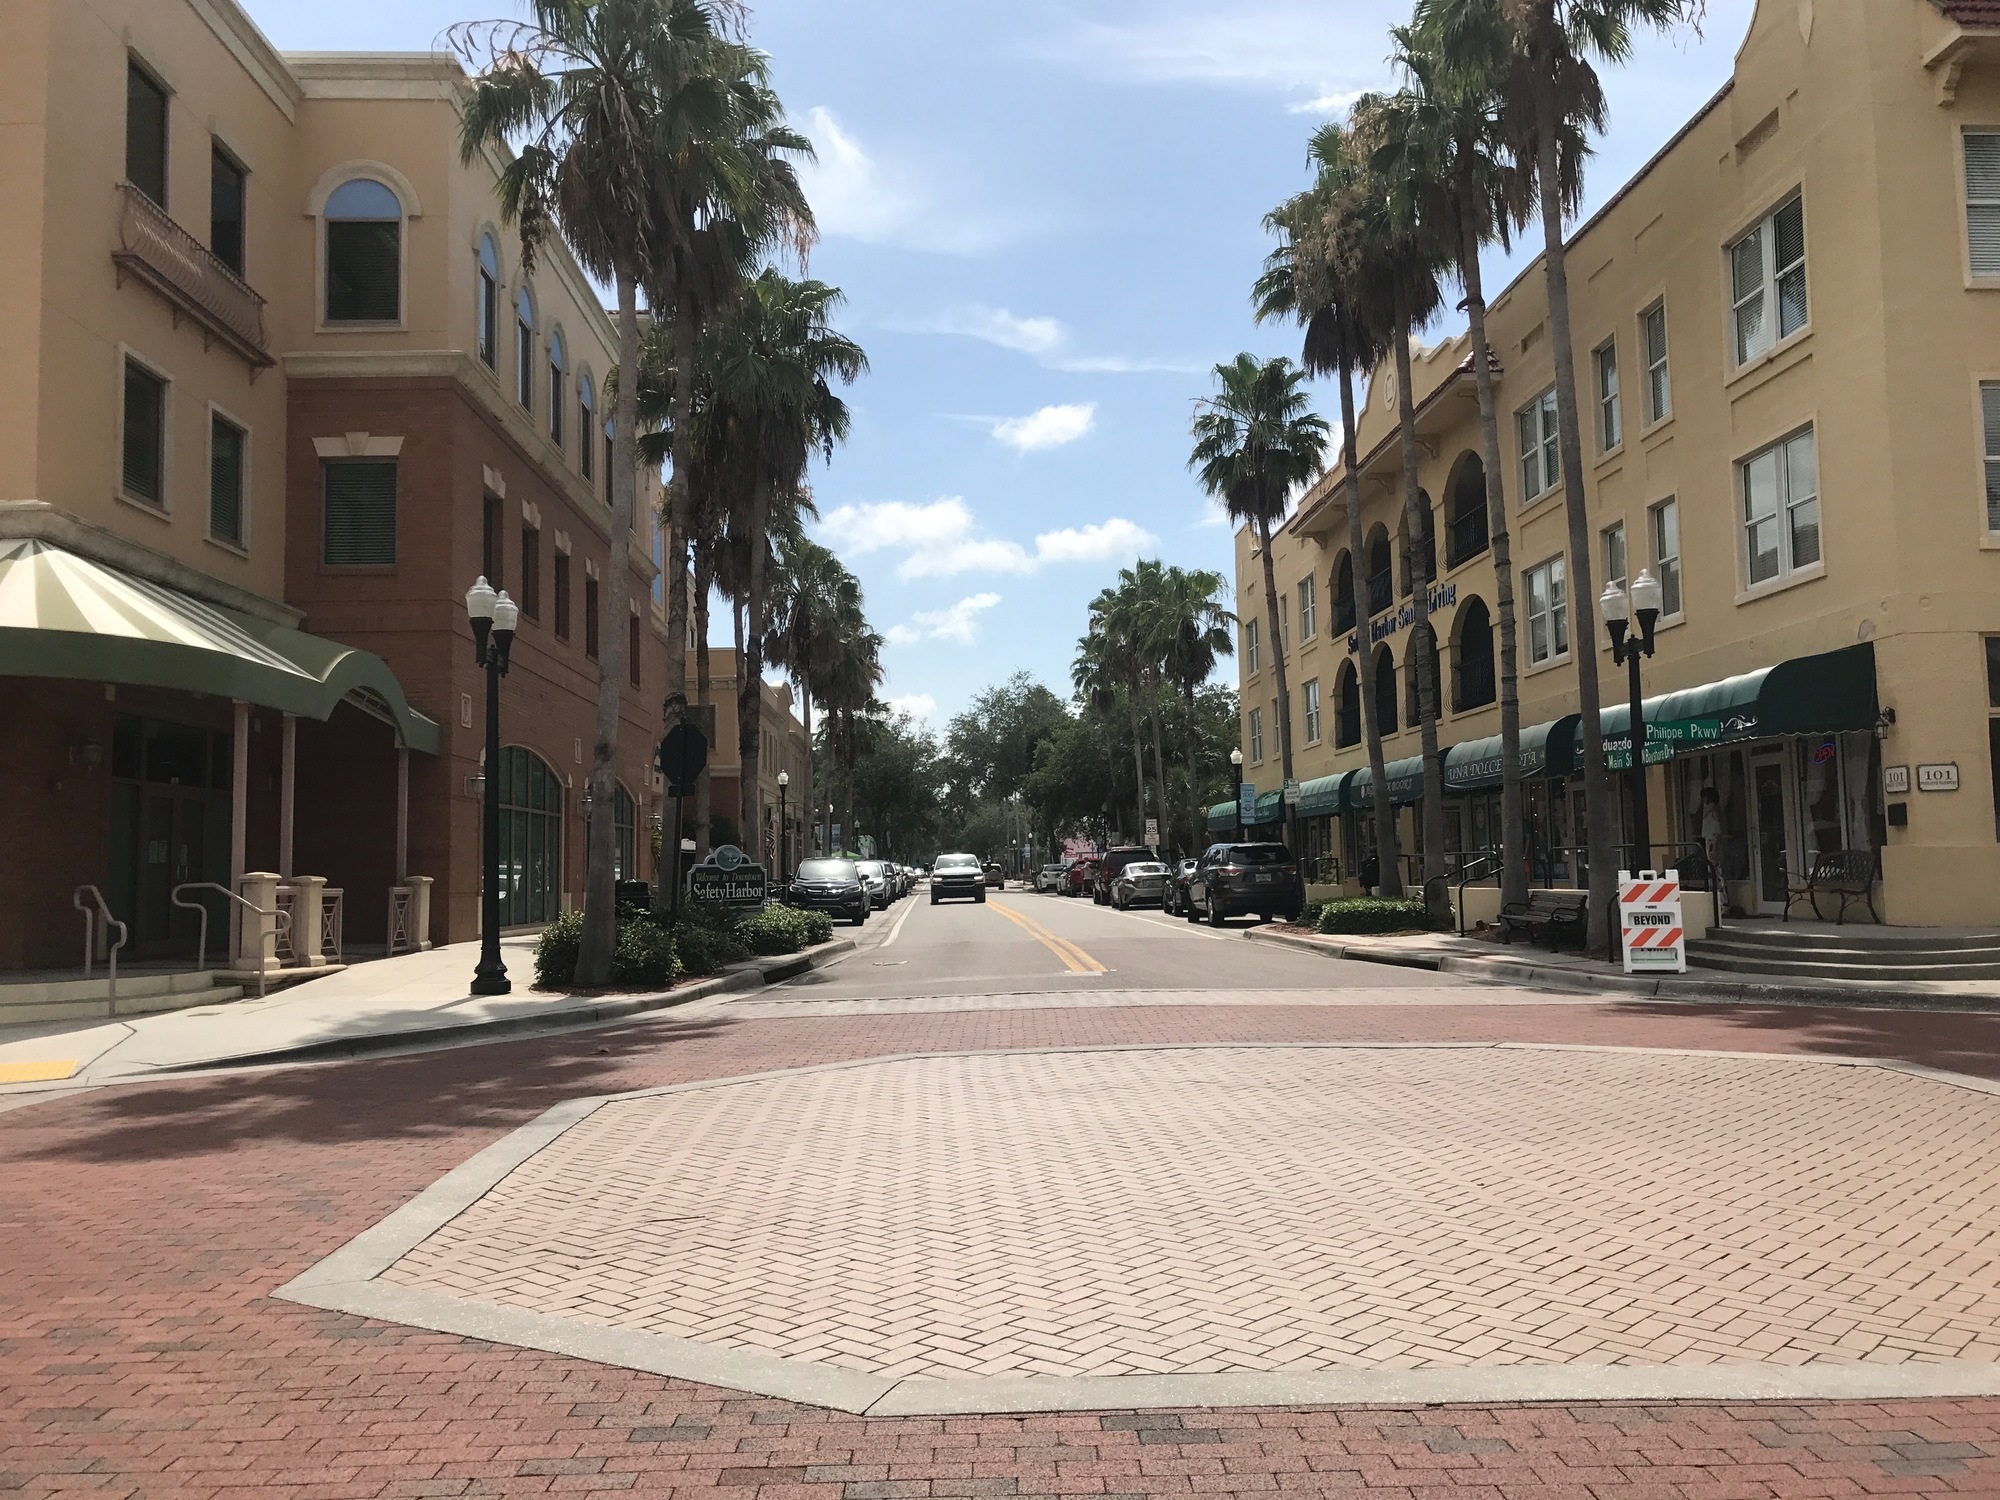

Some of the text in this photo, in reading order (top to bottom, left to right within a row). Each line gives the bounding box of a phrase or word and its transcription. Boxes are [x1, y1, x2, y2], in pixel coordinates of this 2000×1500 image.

[1370, 583, 1456, 643] Harbor Seni Living
[1646, 724, 1683, 740] Philippe
[1690, 723, 1718, 739] Pkwy
[1602, 737, 1632, 752] duardo
[1814, 747, 1834, 759] OPEN
[1608, 753, 1632, 769] Main St
[1448, 762, 1469, 780] UNA
[1470, 758, 1503, 776] DOLCE
[1924, 770, 1953, 781] 101
[1889, 772, 1904, 782] 101
[695, 871, 720, 882] Welcome
[722, 873, 729, 881] to
[1633, 915, 1671, 925] BEYOND
